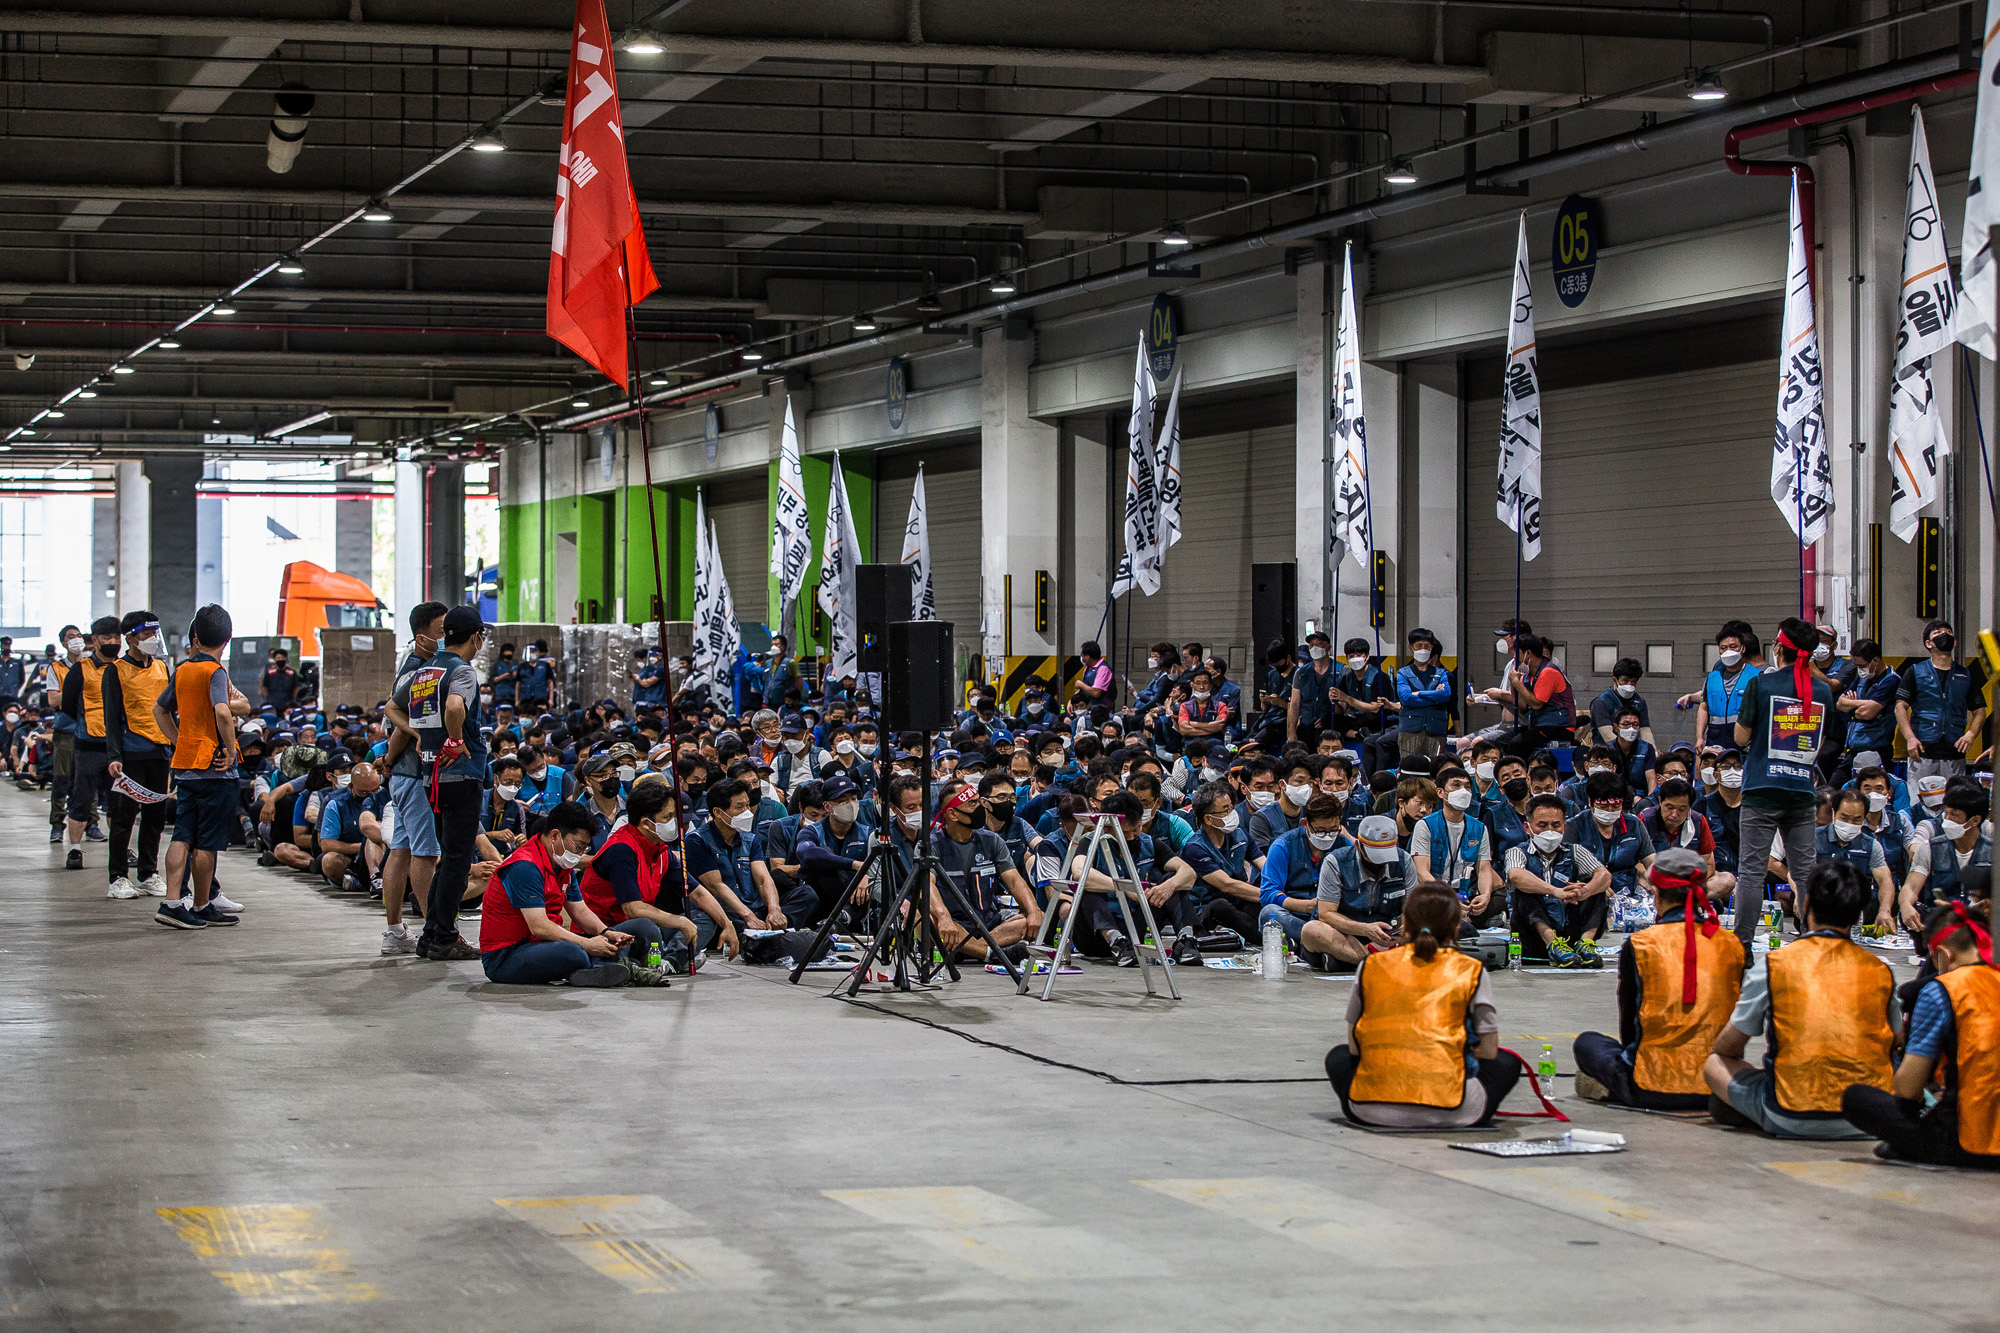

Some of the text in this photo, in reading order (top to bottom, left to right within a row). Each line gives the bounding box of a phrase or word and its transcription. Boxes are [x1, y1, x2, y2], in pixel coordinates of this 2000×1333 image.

[1559, 211, 1589, 265] 05
[1560, 272, 1588, 295] C동3층
[1153, 306, 1172, 347] 04
[889, 367, 903, 401] 03
